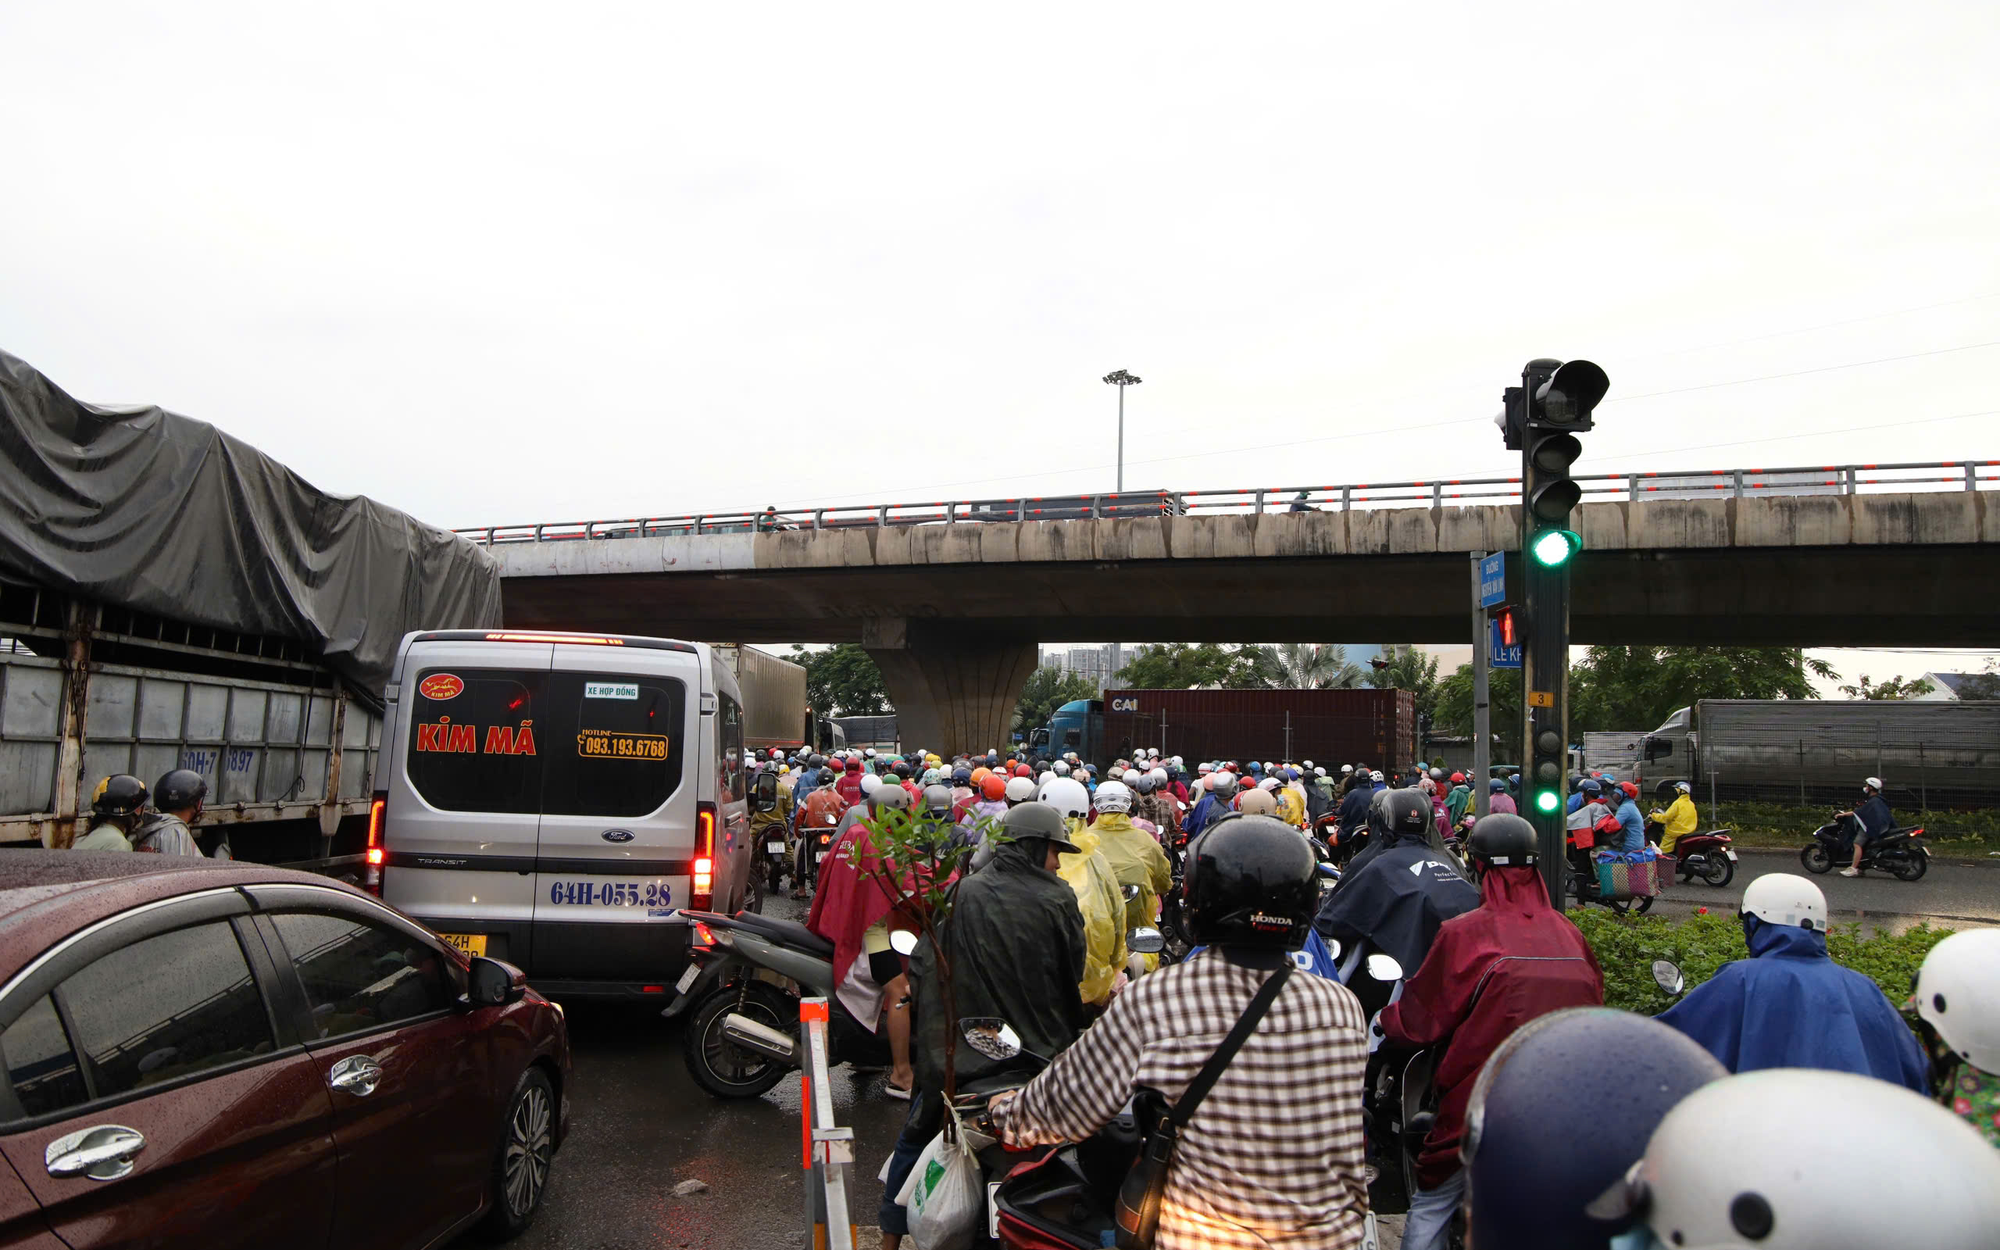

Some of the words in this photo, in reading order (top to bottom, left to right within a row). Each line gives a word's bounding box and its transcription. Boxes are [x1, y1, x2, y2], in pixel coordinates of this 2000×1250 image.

[588, 686, 597, 695] XE
[1538, 693, 1545, 704] 3
[1112, 698, 1138, 711] CAI
[483, 719, 537, 756] MÃ
[582, 728, 612, 736] HOTLINE
[586, 737, 665, 757] 093.193.6768
[608, 831, 627, 841] Ford
[550, 881, 671, 907] 64H-055.28
[1250, 914, 1293, 925] HONDA
